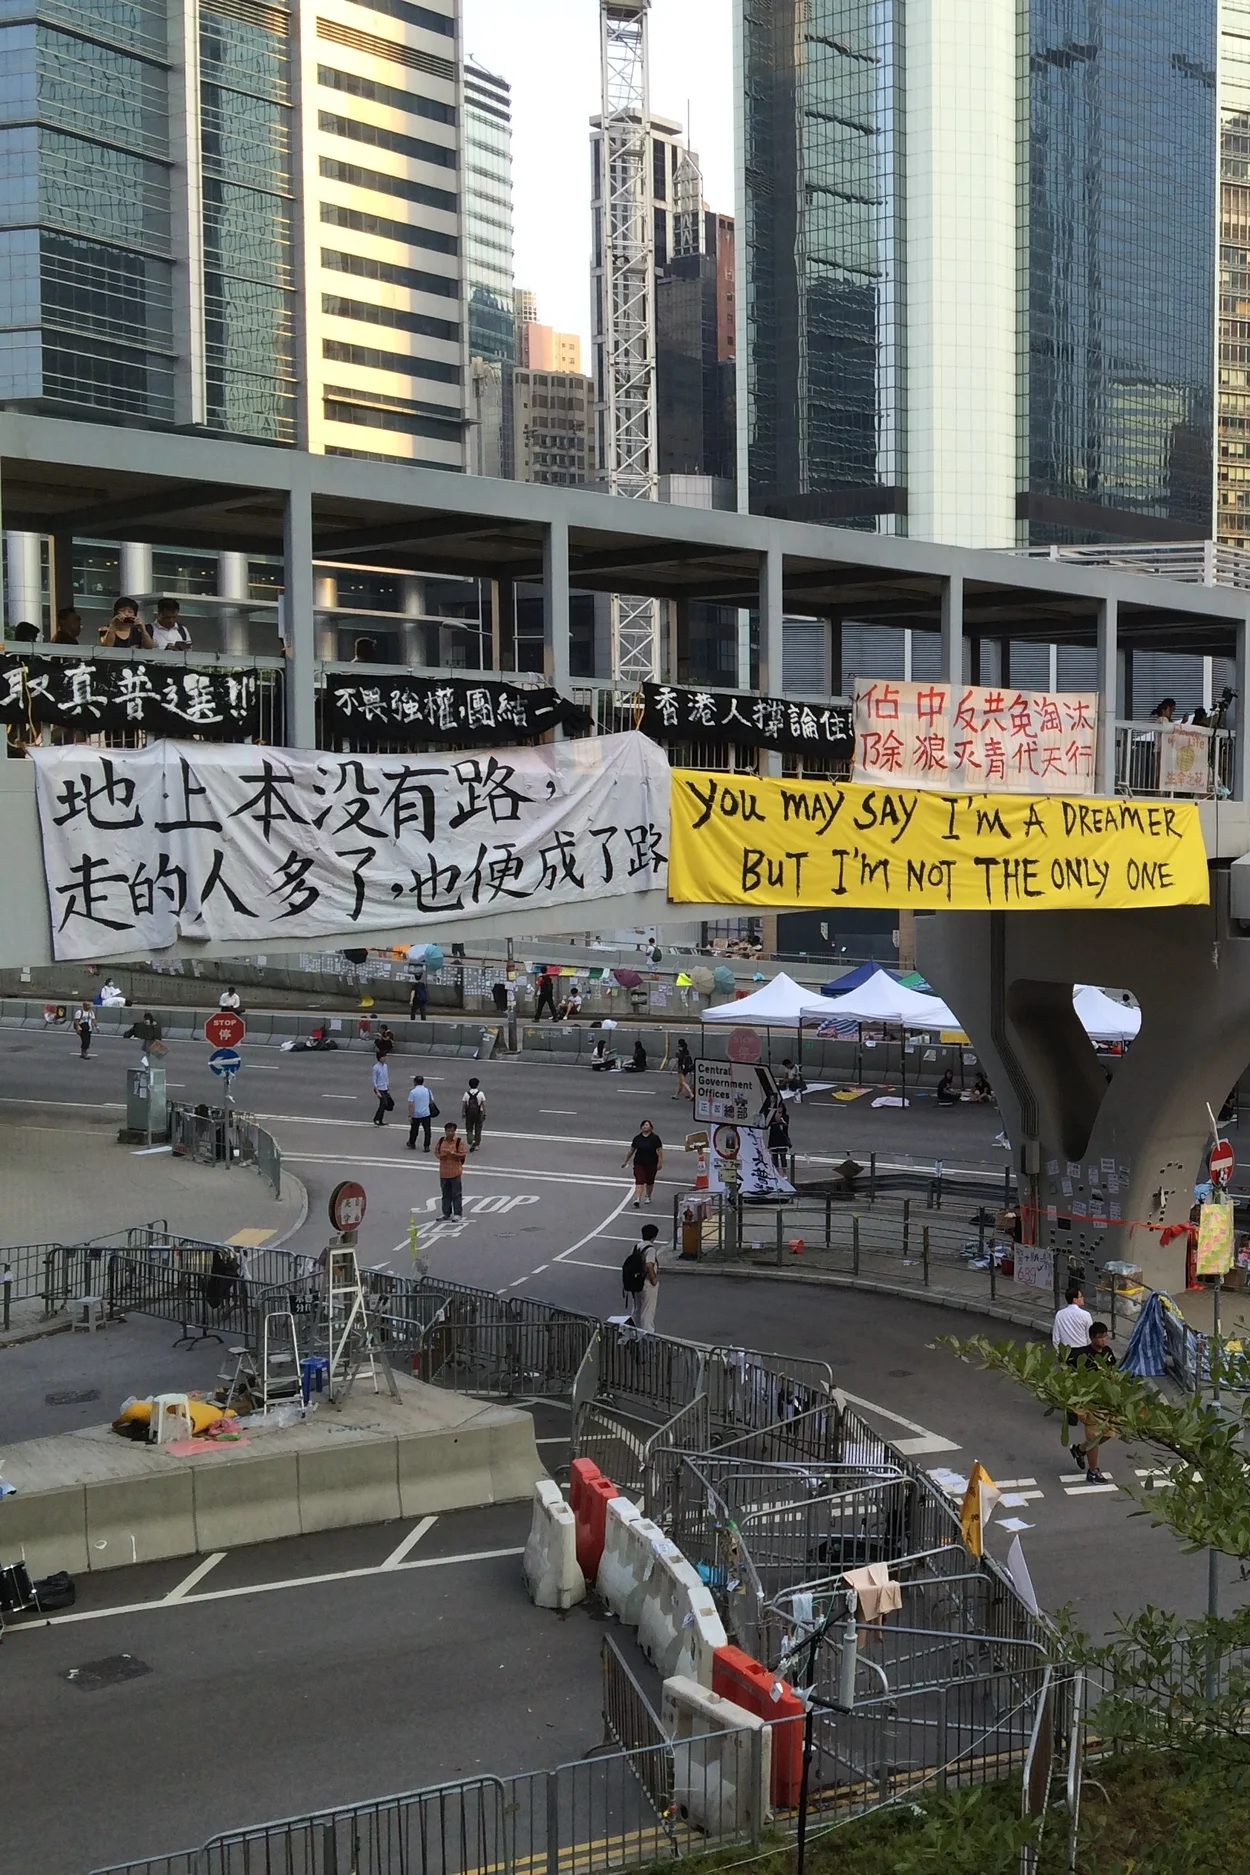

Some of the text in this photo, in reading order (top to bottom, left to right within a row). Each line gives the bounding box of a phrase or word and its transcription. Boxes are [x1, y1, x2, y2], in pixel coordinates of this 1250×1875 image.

[866, 684, 1094, 739] 佔中反共免淘汰
[853, 790, 920, 844] SAY
[1024, 809, 1047, 836] A
[907, 856, 953, 903] NOT
[975, 855, 1044, 904] THE
[1050, 857, 1111, 900] ONLY
[1127, 861, 1174, 891] ONE
[219, 1028, 232, 1041] 停
[698, 1063, 731, 1076] Central
[698, 1075, 753, 1090] Government
[698, 1087, 730, 1099] Offices
